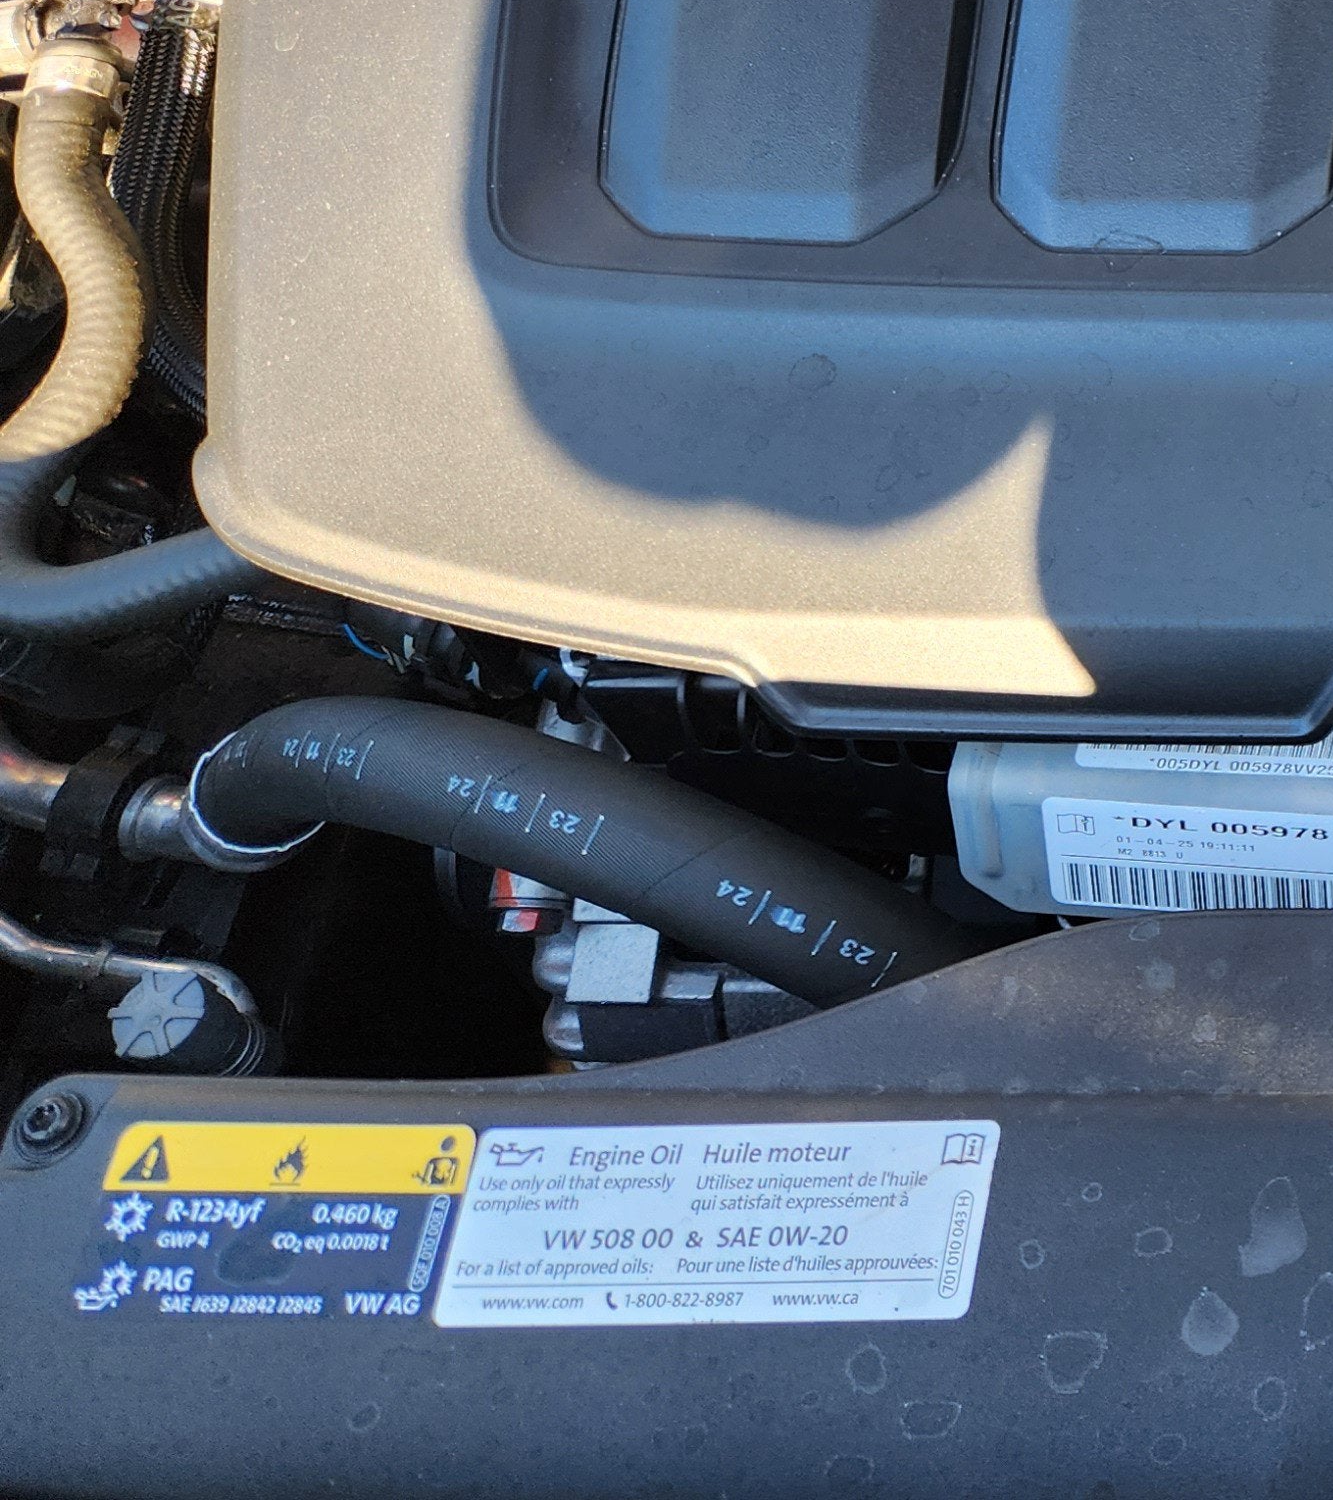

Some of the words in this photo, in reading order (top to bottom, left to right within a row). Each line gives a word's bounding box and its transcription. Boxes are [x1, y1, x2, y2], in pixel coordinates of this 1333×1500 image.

[448, 775, 476, 797] 24
[549, 810, 582, 834] 23
[716, 879, 753, 907] 24
[839, 938, 875, 965] 23
[569, 1146, 644, 1172] Engine
[650, 1144, 684, 1165] Oil
[703, 1142, 762, 1165] Huile
[767, 1145, 851, 1163] moteur
[479, 1176, 508, 1191] Use
[510, 1176, 544, 1196] only
[546, 1176, 566, 1191] oil
[569, 1176, 600, 1191] that
[603, 1174, 675, 1196] expressly
[696, 1174, 755, 1191] Utilisez
[757, 1172, 854, 1195] uniquement
[857, 1171, 877, 1188] de
[881, 1171, 928, 1187] l'huile
[473, 1198, 541, 1215] complies
[545, 1197, 579, 1211] with
[690, 1196, 716, 1215] qui
[719, 1194, 782, 1211] satisfait
[785, 1191, 896, 1213] expressément
[899, 1192, 909, 1208] à
[958, 1196, 970, 1207] H
[165, 1198, 266, 1228] R-1234yf
[312, 1202, 371, 1224] 0.460
[371, 1202, 398, 1230] kg
[952, 1211, 967, 1237] 043
[156, 1231, 198, 1249] GWP
[199, 1231, 210, 1248] 4
[303, 1235, 326, 1254] eq
[327, 1232, 379, 1250] 0.0018
[380, 1233, 390, 1251] t
[543, 1230, 586, 1250] VW
[590, 1229, 635, 1250] 508
[641, 1228, 674, 1248] 00
[685, 1231, 703, 1248] &
[716, 1227, 762, 1248] SAE
[768, 1225, 848, 1247] 0W-20
[677, 1258, 712, 1274] Pour
[719, 1260, 745, 1273] une
[748, 1256, 781, 1273] liste
[783, 1255, 841, 1271] d'huiles
[844, 1254, 939, 1275] approuvées:
[947, 1241, 962, 1266] 010
[143, 1267, 194, 1292] PAG
[456, 1261, 482, 1276] For
[484, 1264, 494, 1276] a
[499, 1260, 524, 1276] list
[526, 1260, 542, 1276] of
[543, 1258, 617, 1280] approved
[621, 1258, 654, 1274] oils:
[942, 1270, 957, 1293] 701
[159, 1294, 192, 1314] SAE
[344, 1292, 385, 1315] VW
[385, 1292, 422, 1316] AG
[482, 1295, 584, 1310] www.vw.com
[625, 1292, 743, 1308] 1-800-822-8987
[772, 1293, 859, 1307] www.vw.ca
